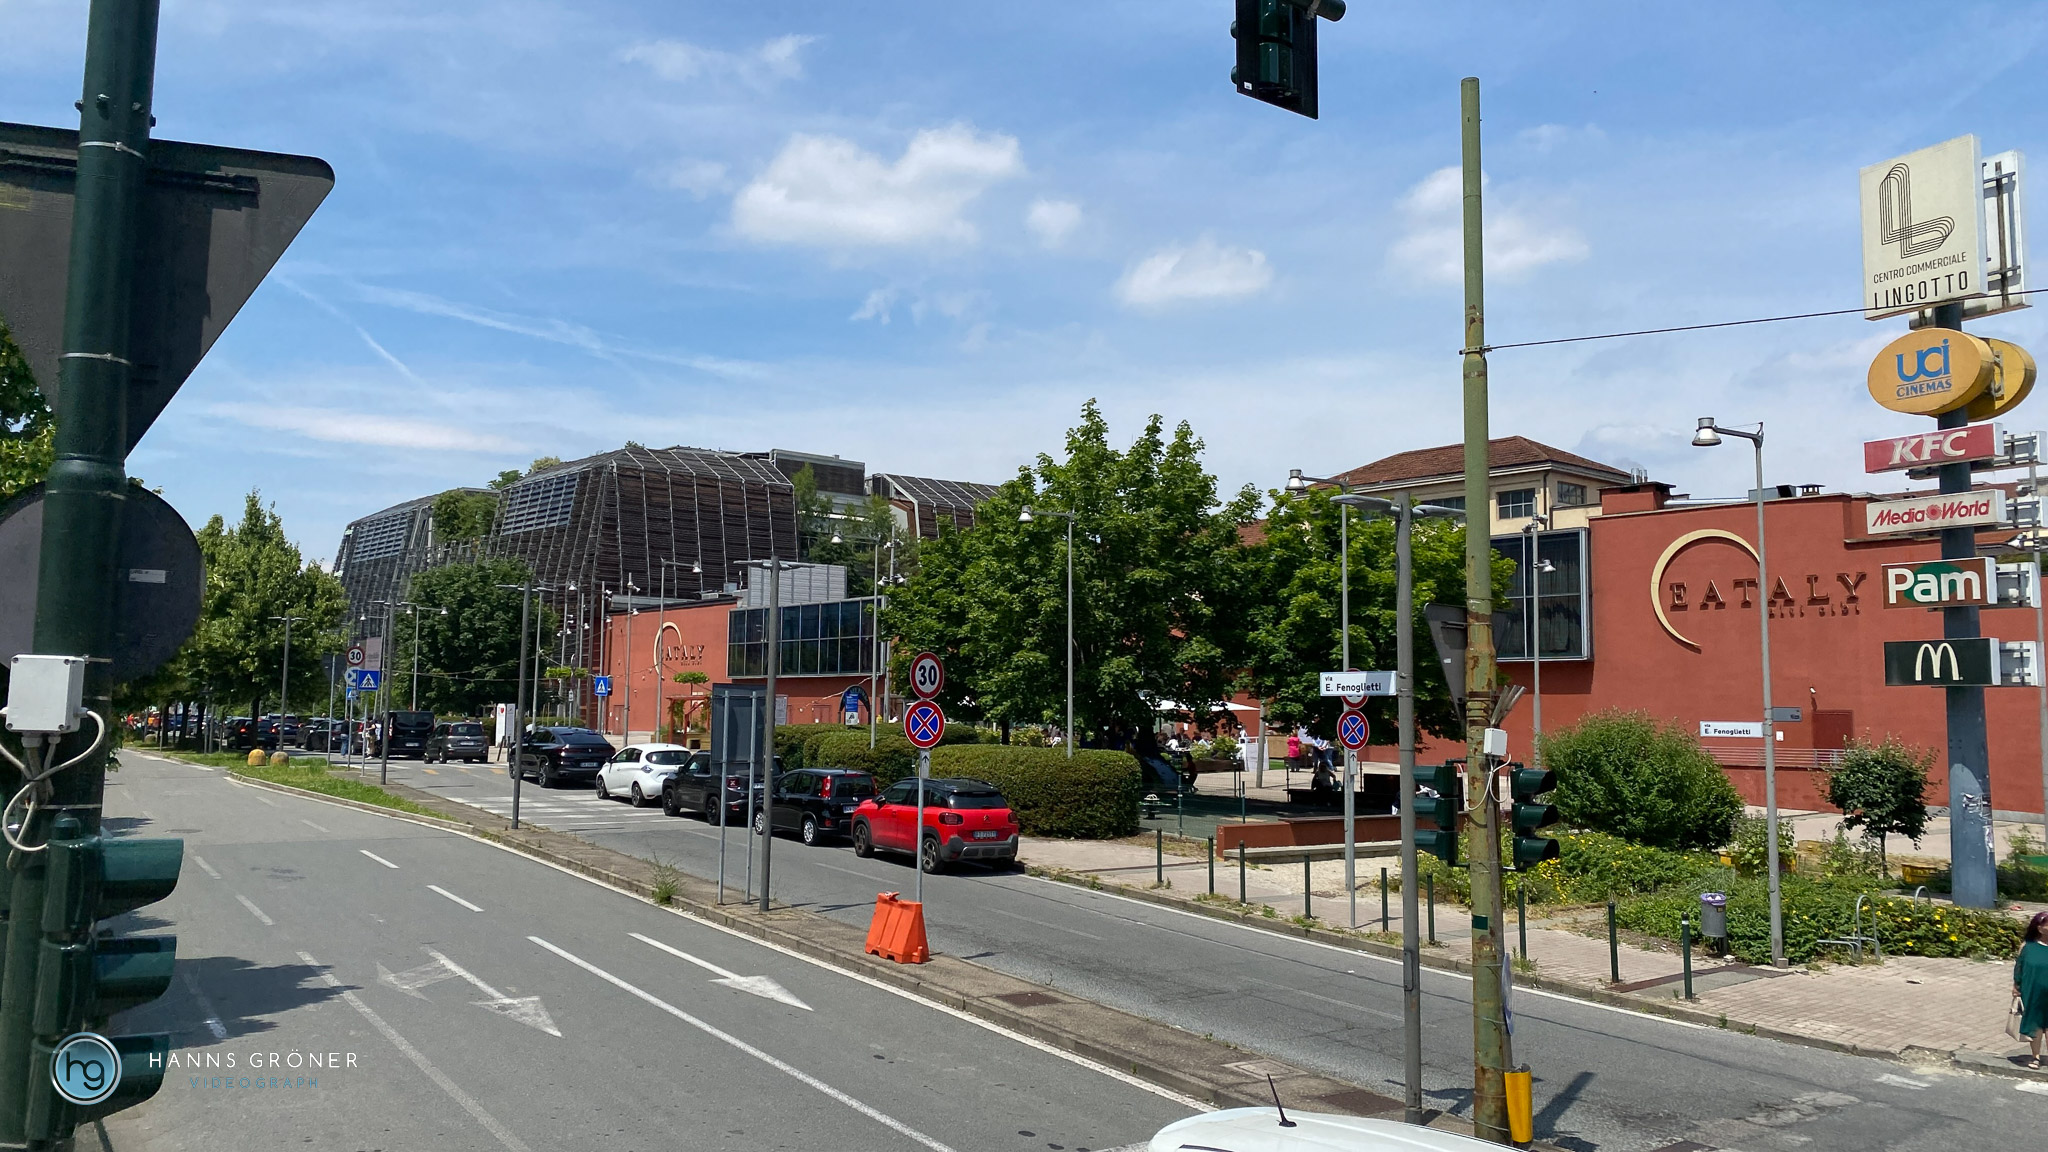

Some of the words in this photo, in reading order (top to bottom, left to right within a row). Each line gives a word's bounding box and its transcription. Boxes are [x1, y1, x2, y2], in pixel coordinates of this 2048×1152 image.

[1873, 267, 1905, 284] CENTRO
[1906, 251, 1967, 276] COMMERCIALE
[1874, 270, 1968, 310] LINGOTTO
[1896, 379, 1952, 397] CINEMAS
[1889, 431, 1968, 465] KFC
[1872, 508, 1925, 527] Media
[1942, 500, 1990, 519] World
[1669, 572, 1867, 611] EATALY
[1888, 568, 1981, 604] Pam
[350, 651, 361, 661] 30
[661, 645, 704, 660] ATALY
[919, 665, 937, 686] 30
[1325, 683, 1333, 692] E.
[1336, 682, 1382, 693] Fenoglietti
[1713, 728, 1751, 736] Fenoglietti
